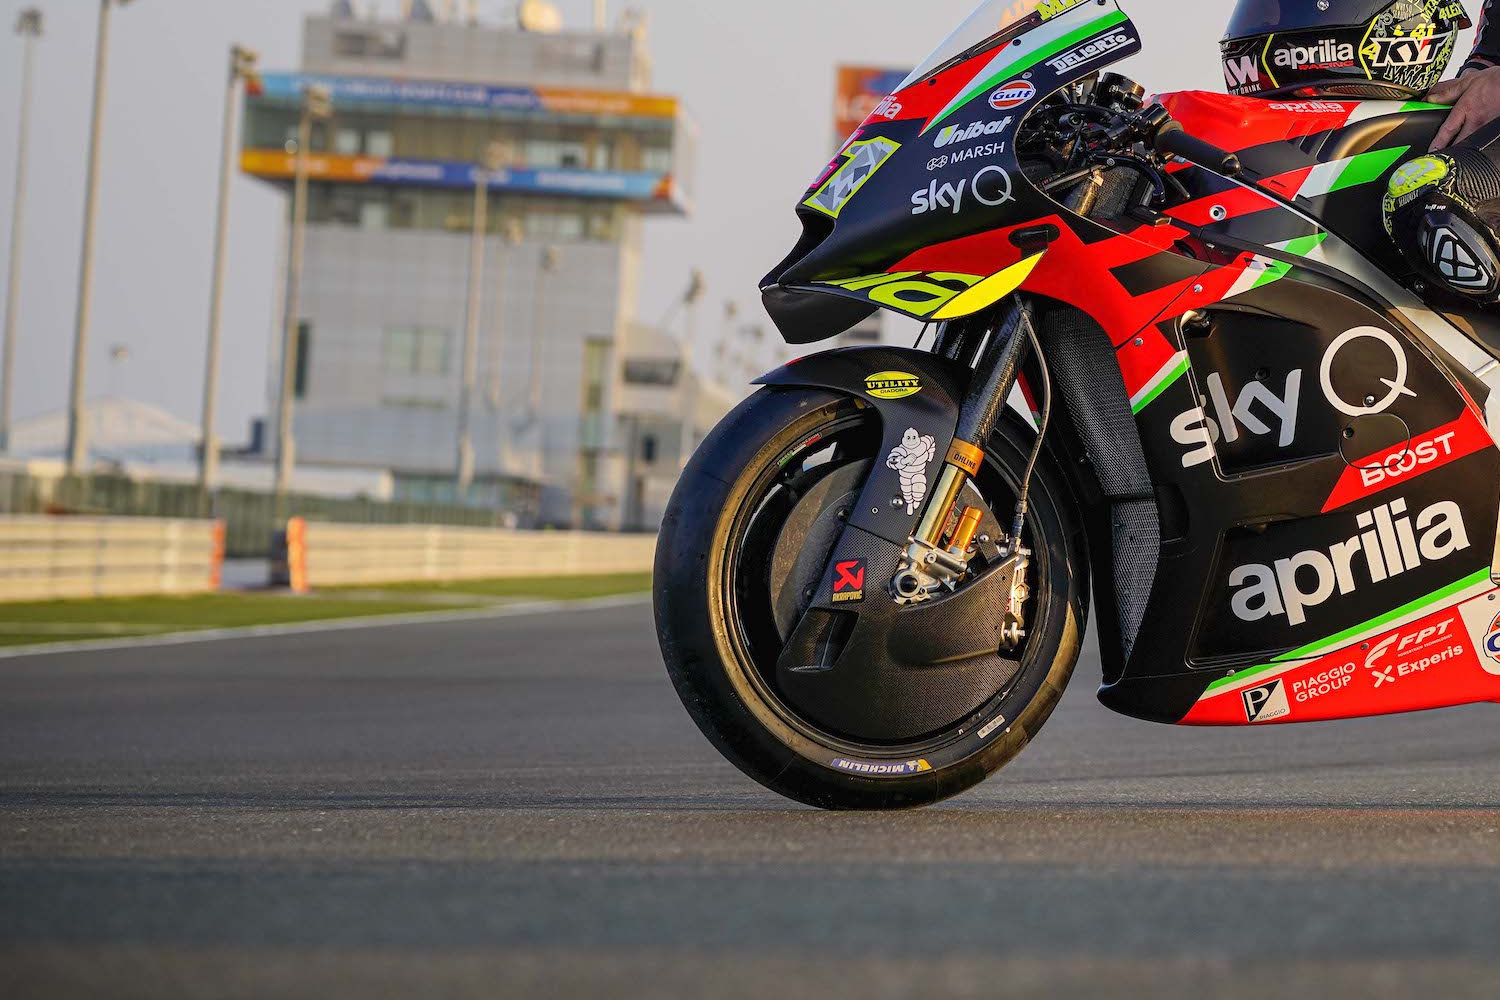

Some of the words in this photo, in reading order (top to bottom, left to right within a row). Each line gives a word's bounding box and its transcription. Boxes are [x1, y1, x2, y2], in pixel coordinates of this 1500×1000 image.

[1274, 39, 1354, 69] aprilia
[1298, 60, 1354, 70] RACING
[1370, 33, 1453, 67] KYT
[993, 90, 1032, 100] Gulf
[1241, 83, 1262, 95] DRINK
[1268, 101, 1344, 111] aprilia
[934, 115, 1015, 148] Unibat
[950, 141, 1005, 164] MARSH
[911, 179, 966, 215] sky
[971, 165, 1017, 206] Q
[867, 380, 919, 389] UTILITY
[1169, 368, 1302, 469] sky
[1319, 325, 1417, 416] Q
[1359, 431, 1455, 488] BOOST
[1228, 497, 1471, 627] aprilia
[1397, 618, 1454, 651] FPT
[1397, 643, 1463, 677] Experis
[1292, 662, 1355, 693] PIAGGIO
[1295, 675, 1352, 702] GROUP
[1259, 707, 1286, 720] PIAGGIO
[838, 759, 904, 773] MICHELIN
